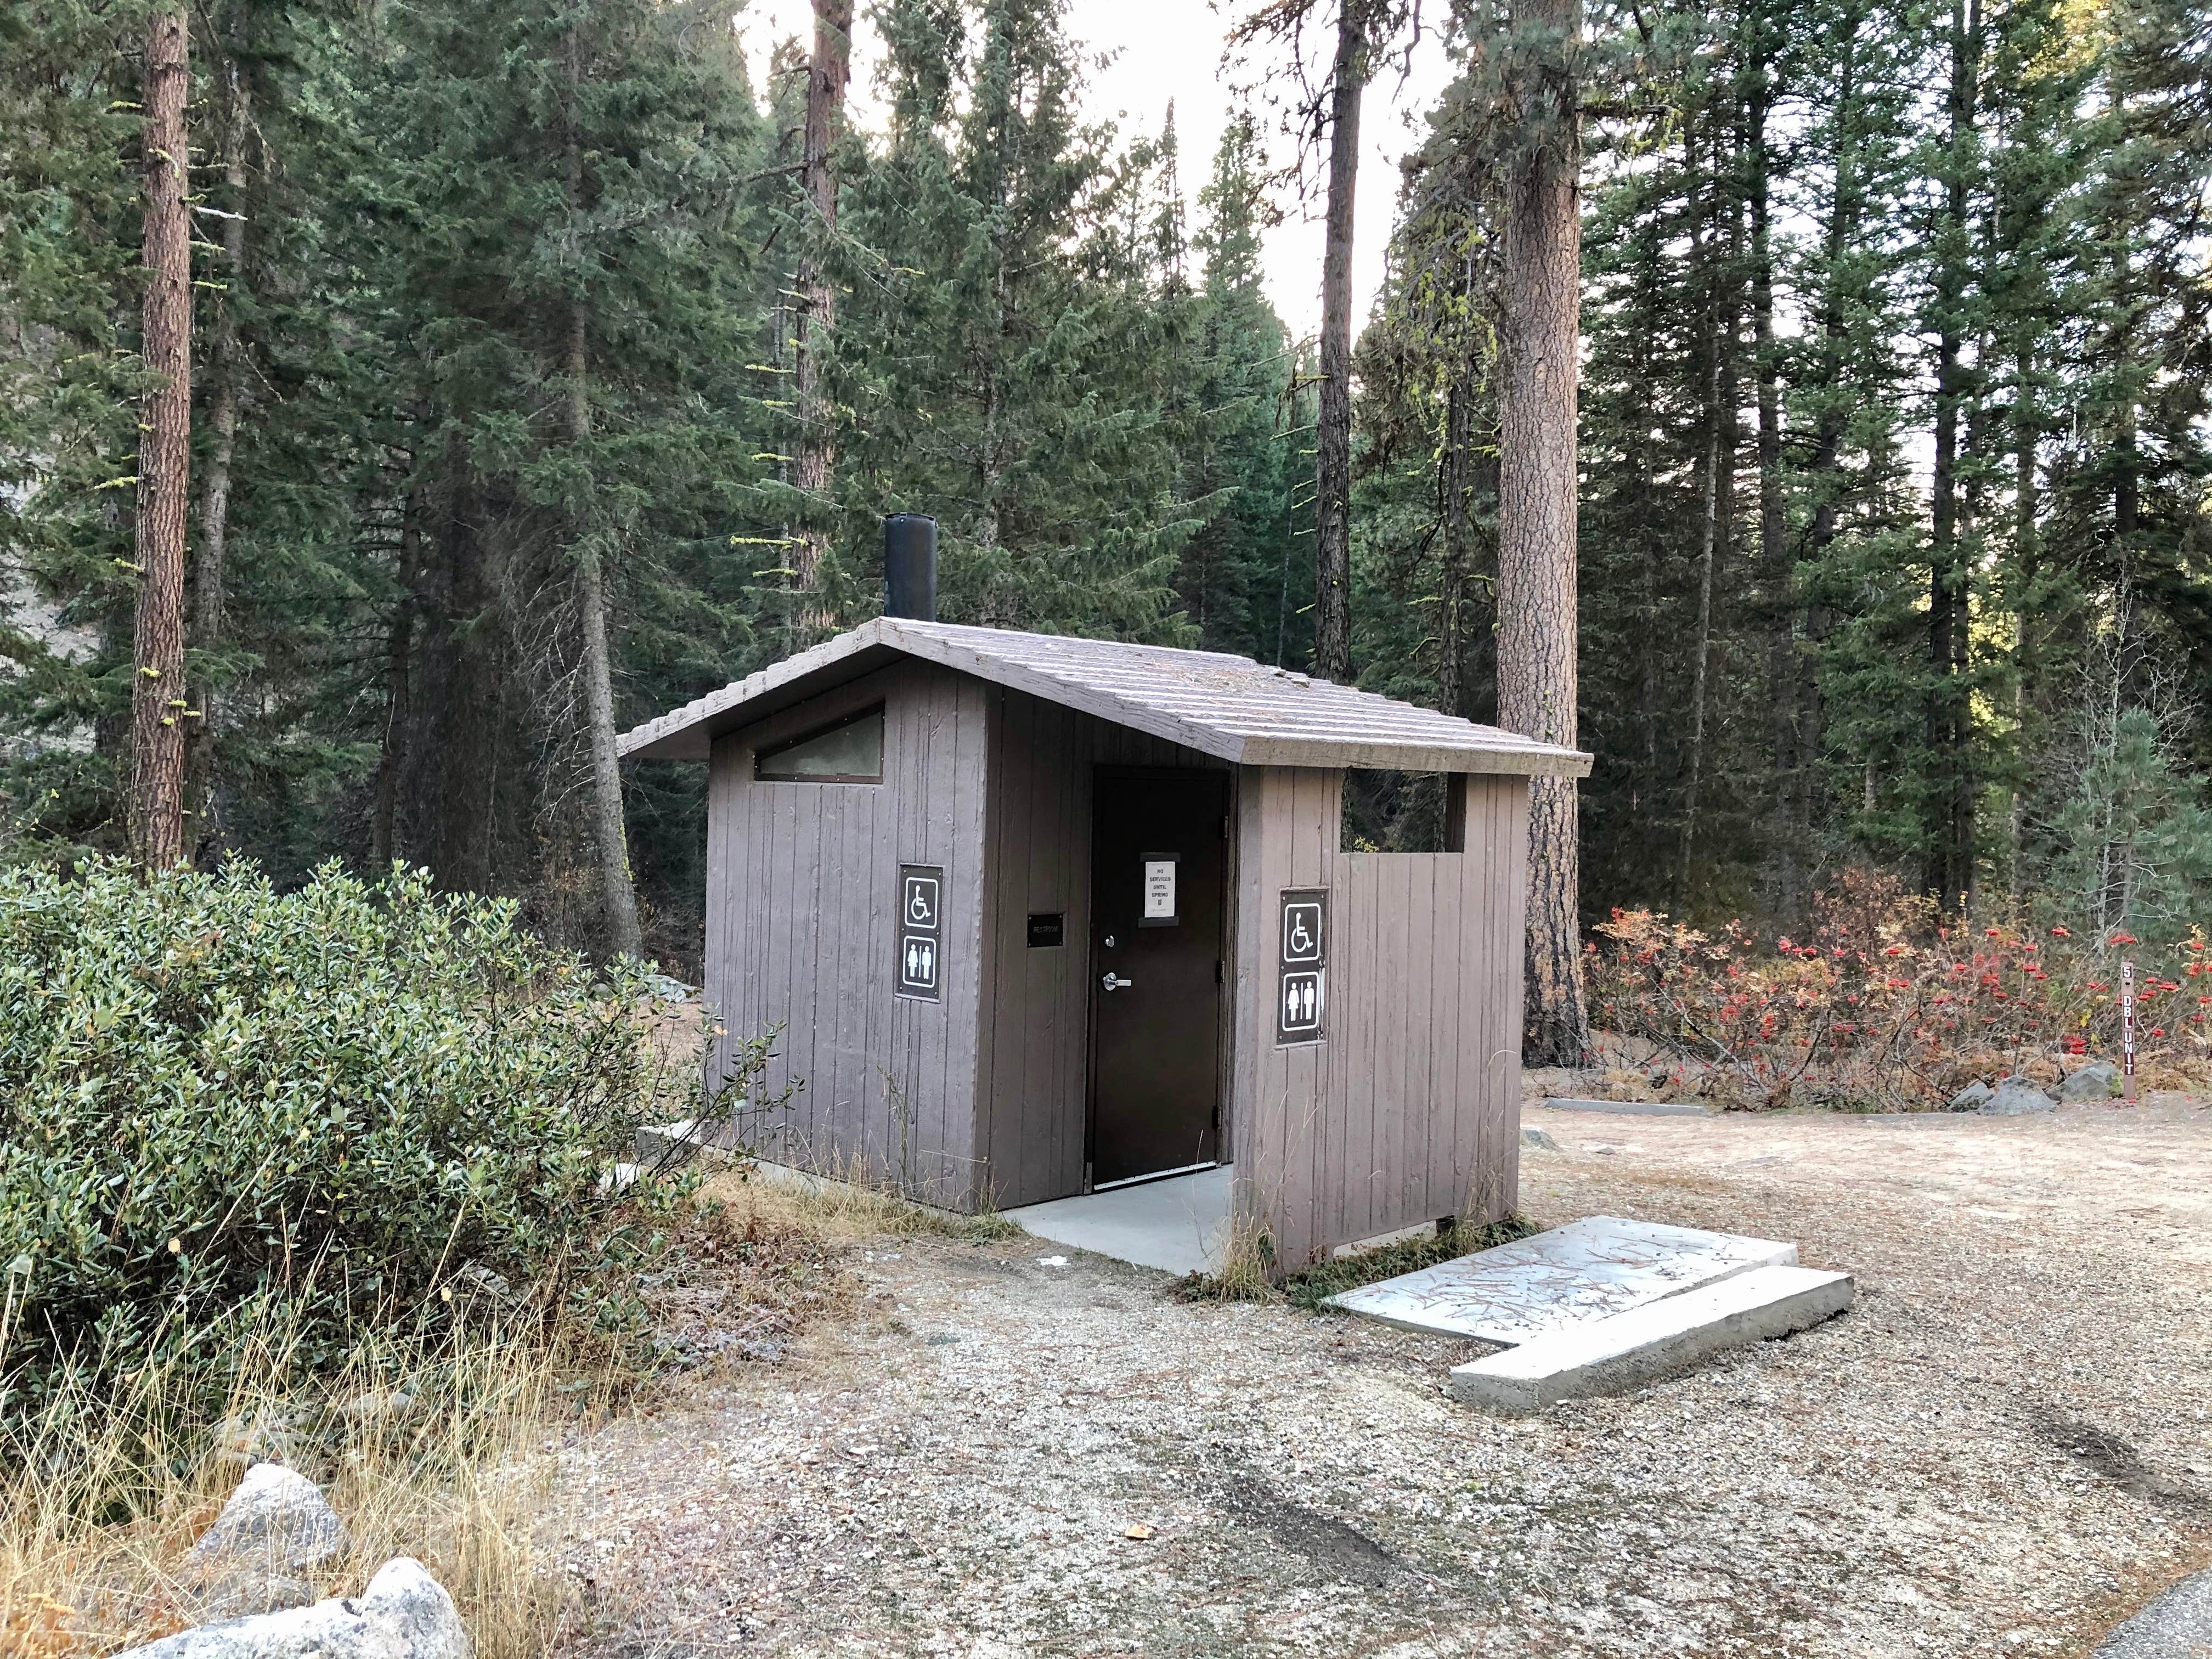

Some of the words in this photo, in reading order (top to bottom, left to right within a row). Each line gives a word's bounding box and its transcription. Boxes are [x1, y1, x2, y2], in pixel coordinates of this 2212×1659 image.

[2124, 966, 2131, 978] 5
[2124, 995, 2132, 1028] DBL
[2124, 1032, 2134, 1075] UNIT
